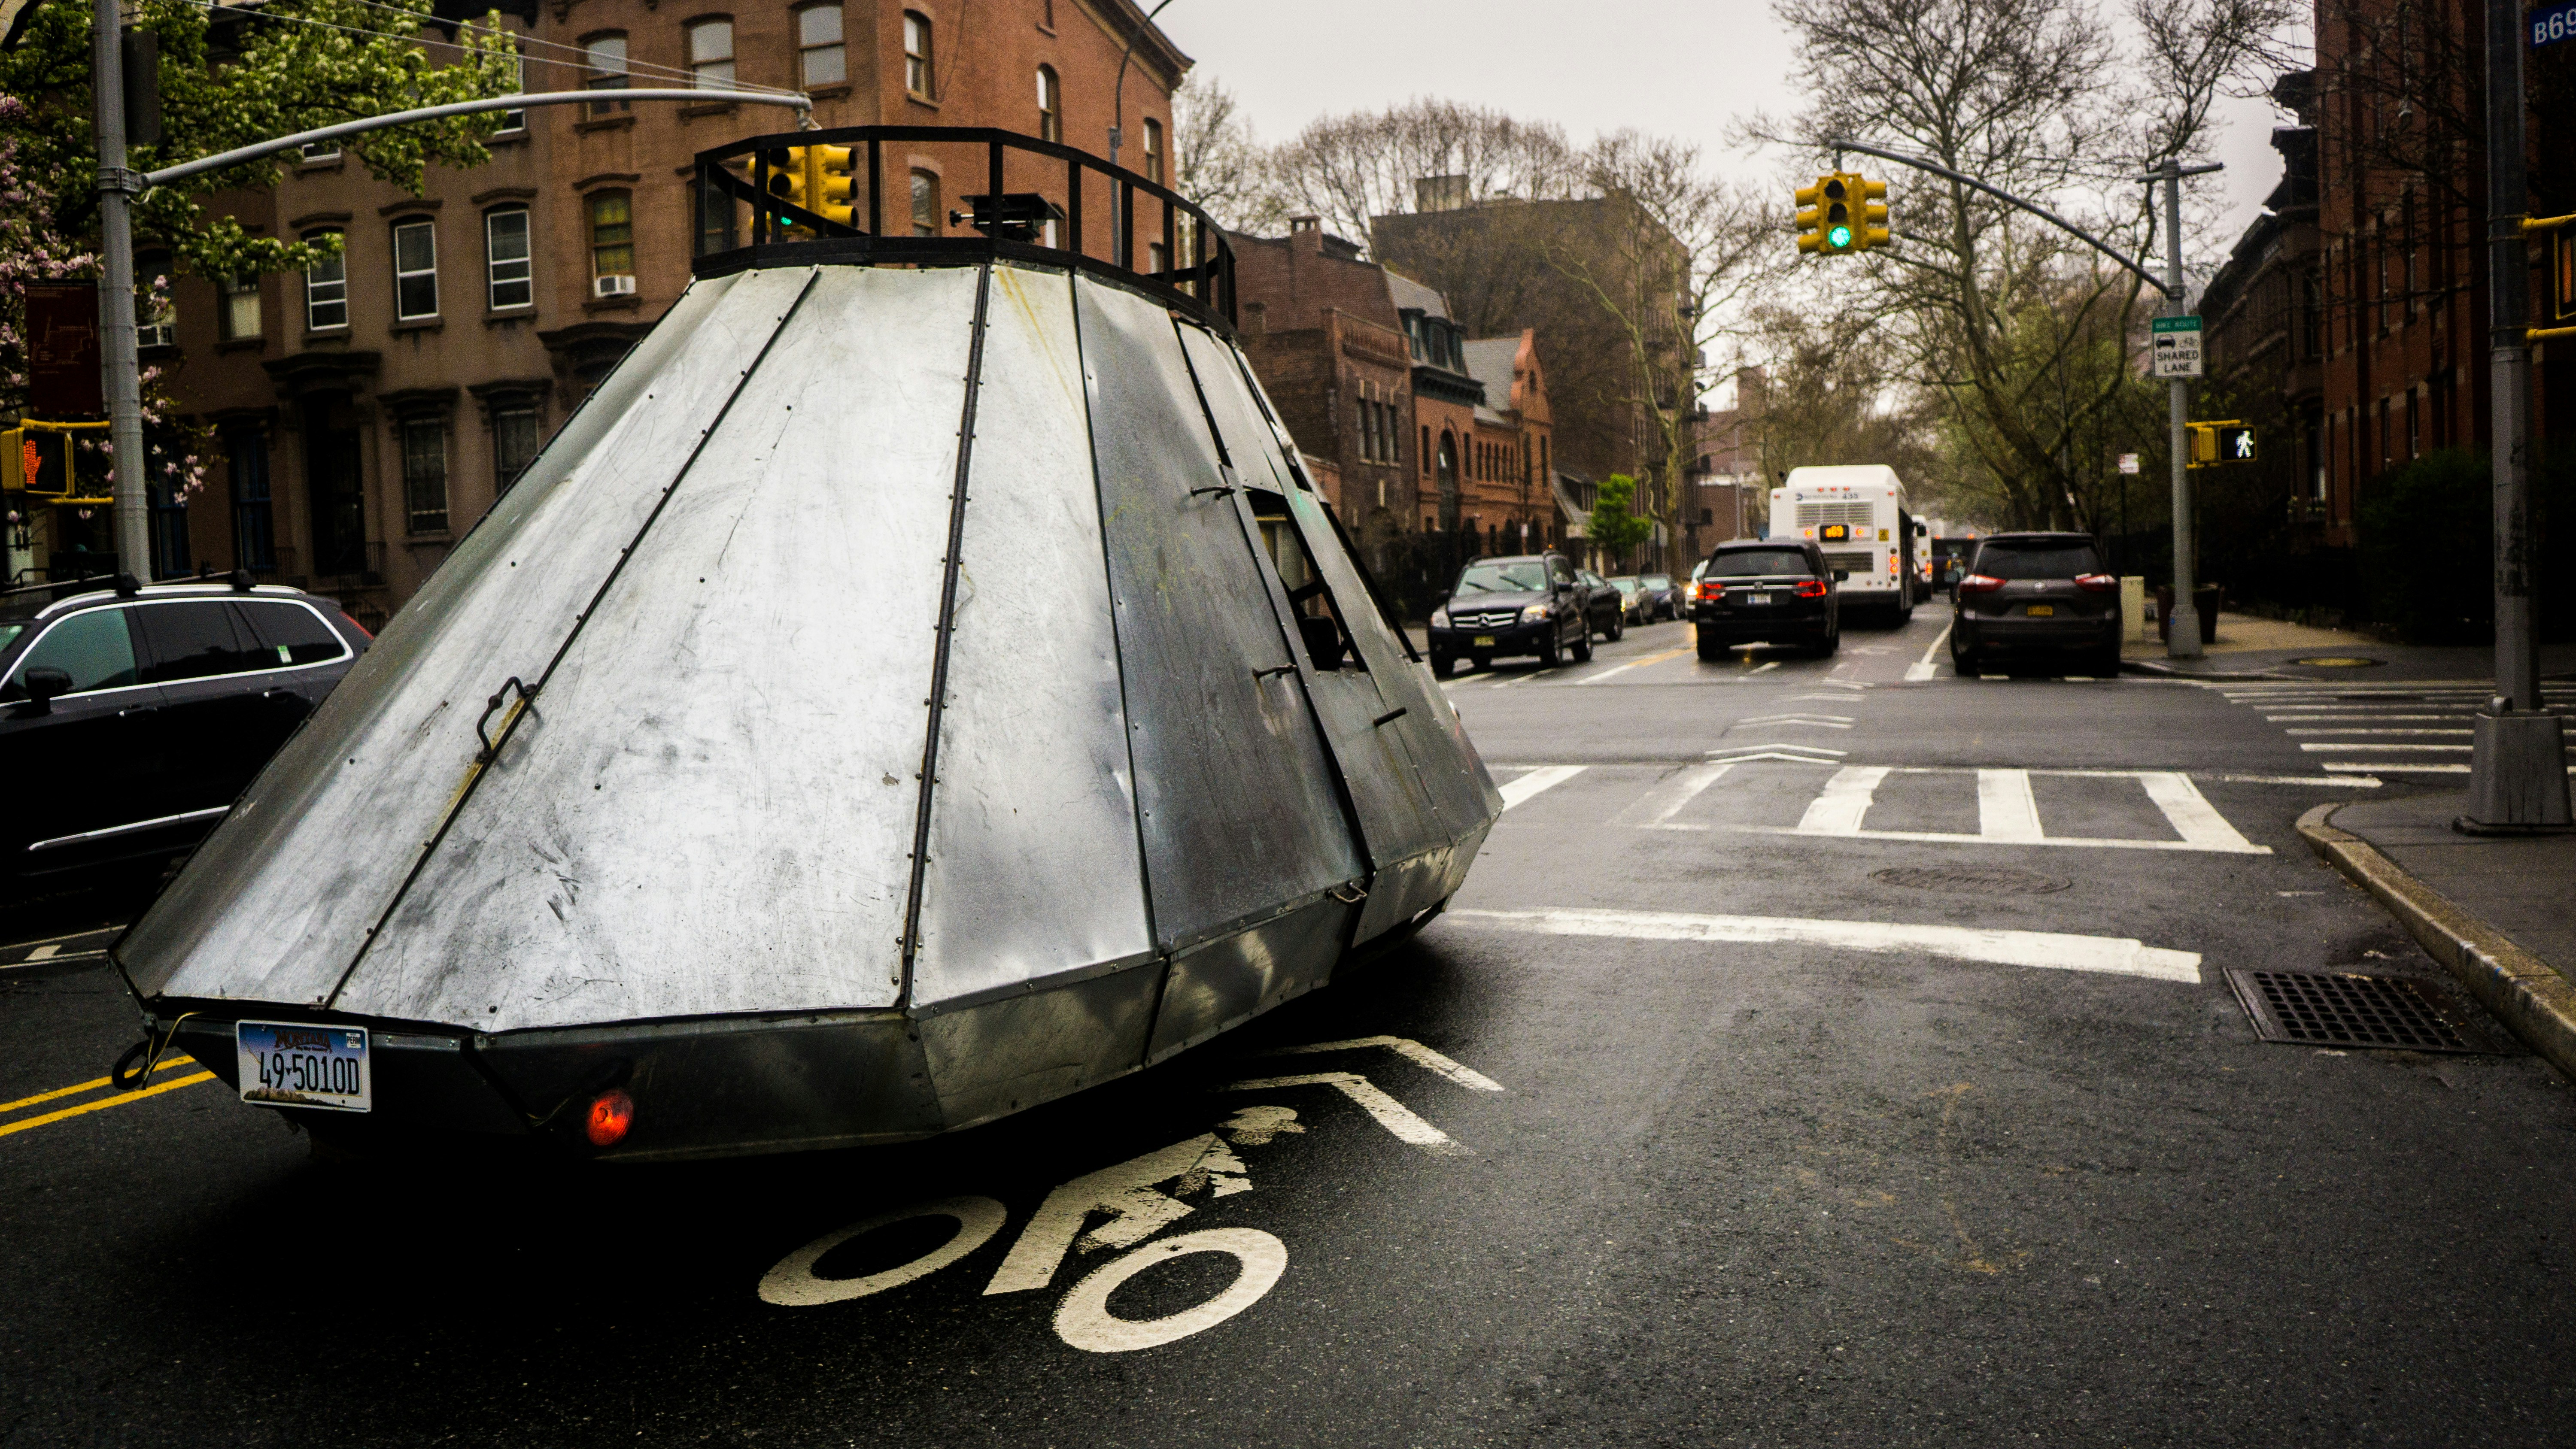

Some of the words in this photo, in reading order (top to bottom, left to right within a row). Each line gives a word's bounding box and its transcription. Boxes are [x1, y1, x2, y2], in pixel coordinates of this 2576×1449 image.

[2535, 8, 2576, 44] B69
[2157, 350, 2199, 361] SHARED
[2164, 362, 2192, 373] LANE
[274, 1030, 332, 1053] MONTANA
[347, 1036, 361, 1044] PERM
